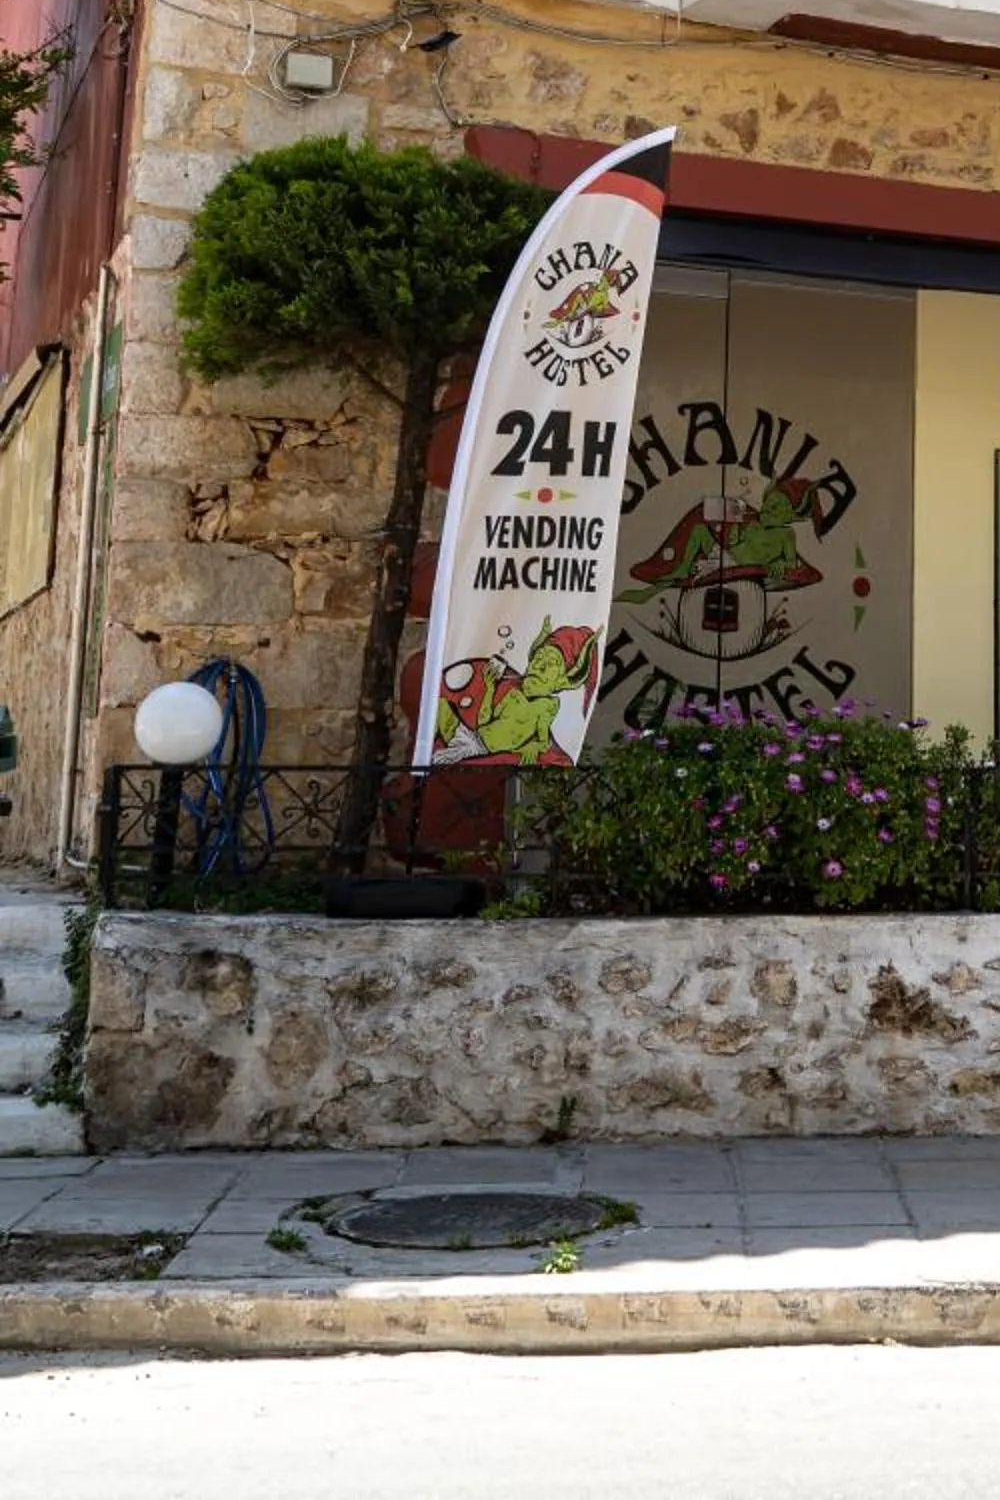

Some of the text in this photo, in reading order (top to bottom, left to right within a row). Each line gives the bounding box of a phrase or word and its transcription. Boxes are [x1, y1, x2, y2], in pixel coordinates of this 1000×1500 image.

[533, 241, 639, 297] CHANIA
[523, 337, 631, 388] HOSTEL
[485, 515, 605, 551] VENDING
[473, 556, 599, 593] MACHINE
